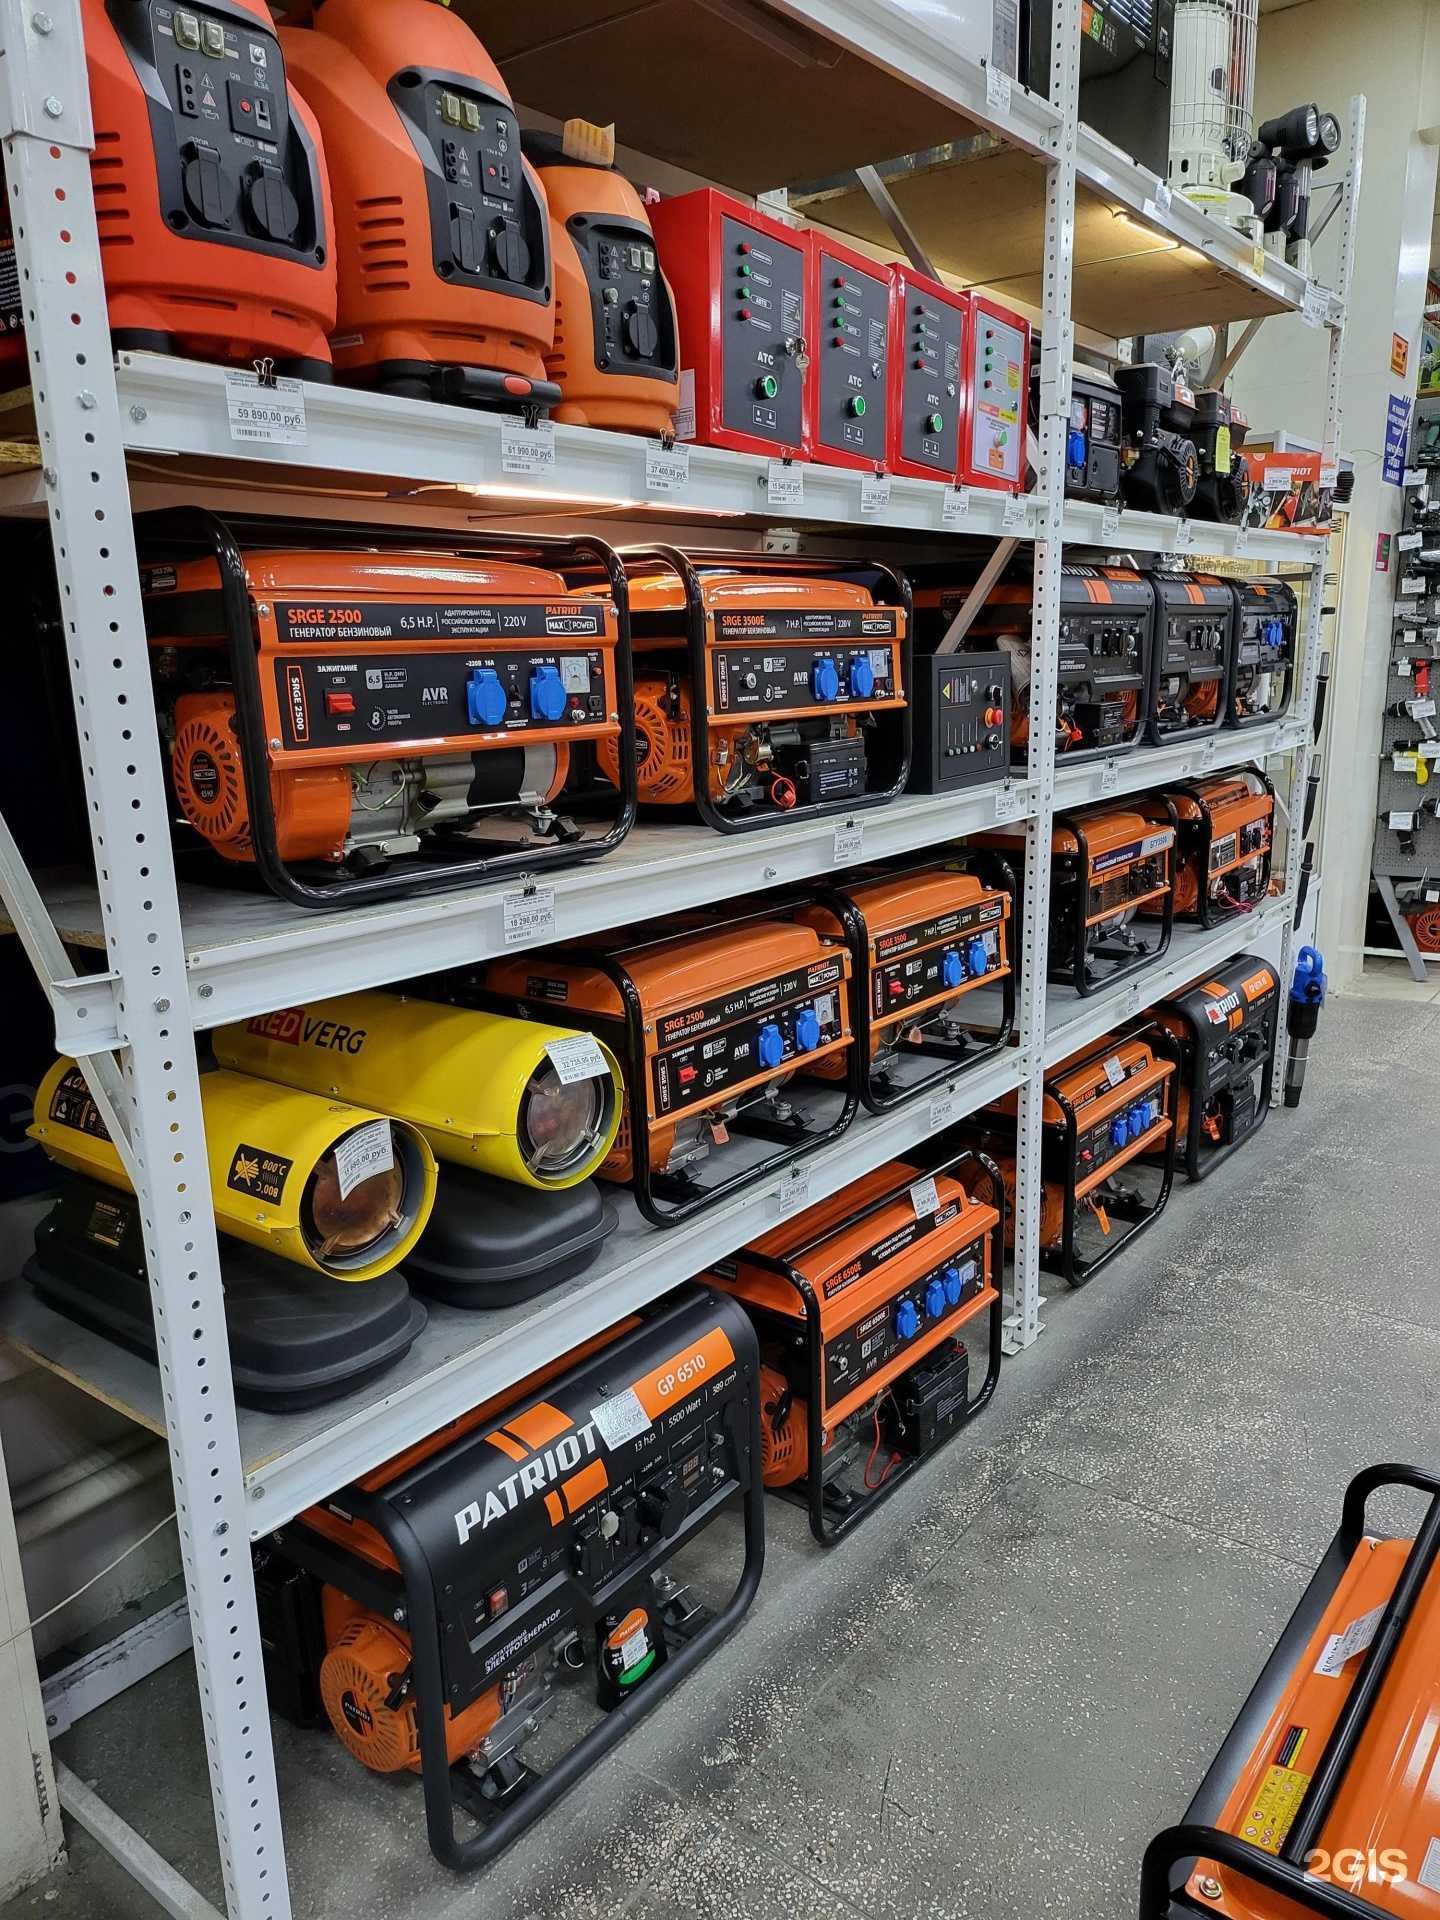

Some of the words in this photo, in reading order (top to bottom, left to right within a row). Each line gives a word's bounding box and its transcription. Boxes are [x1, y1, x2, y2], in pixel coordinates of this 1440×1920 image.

[238, 408, 249, 418] 59
[251, 410, 282, 422] 890,00
[284, 414, 304, 425] руб.
[287, 608, 325, 624] SRGE
[328, 609, 362, 624] 2500
[545, 606, 582, 615] PATRIOT
[400, 616, 416, 630] 6,5
[503, 616, 519, 627] 220
[548, 621, 564, 630] MAX
[572, 621, 595, 630] POWER
[722, 615, 741, 626] SRGE
[290, 627, 336, 638] ГЕНЕРАТОР
[338, 626, 392, 638] БЕНЗИНОВЫЙ
[317, 664, 359, 673] ЗАЖИГАНИЕ
[793, 672, 808, 682] AVR
[291, 677, 302, 704] SRGE
[422, 687, 448, 701] AVR
[295, 705, 305, 730] 2500
[664, 1017, 686, 1033] SRGE
[686, 1009, 705, 1025] 2500
[734, 1043, 750, 1058] AVR
[825, 1273, 843, 1291] SRGE
[657, 1374, 675, 1397] GP
[677, 1354, 706, 1384] 6510
[634, 1440, 643, 1453] 13
[668, 1409, 685, 1429] 5500
[685, 1398, 702, 1416] Watt
[454, 1420, 598, 1545] PATRIOT
[485, 1608, 562, 1675] ЭЛЕКТРОГЕНЕРАТОР
